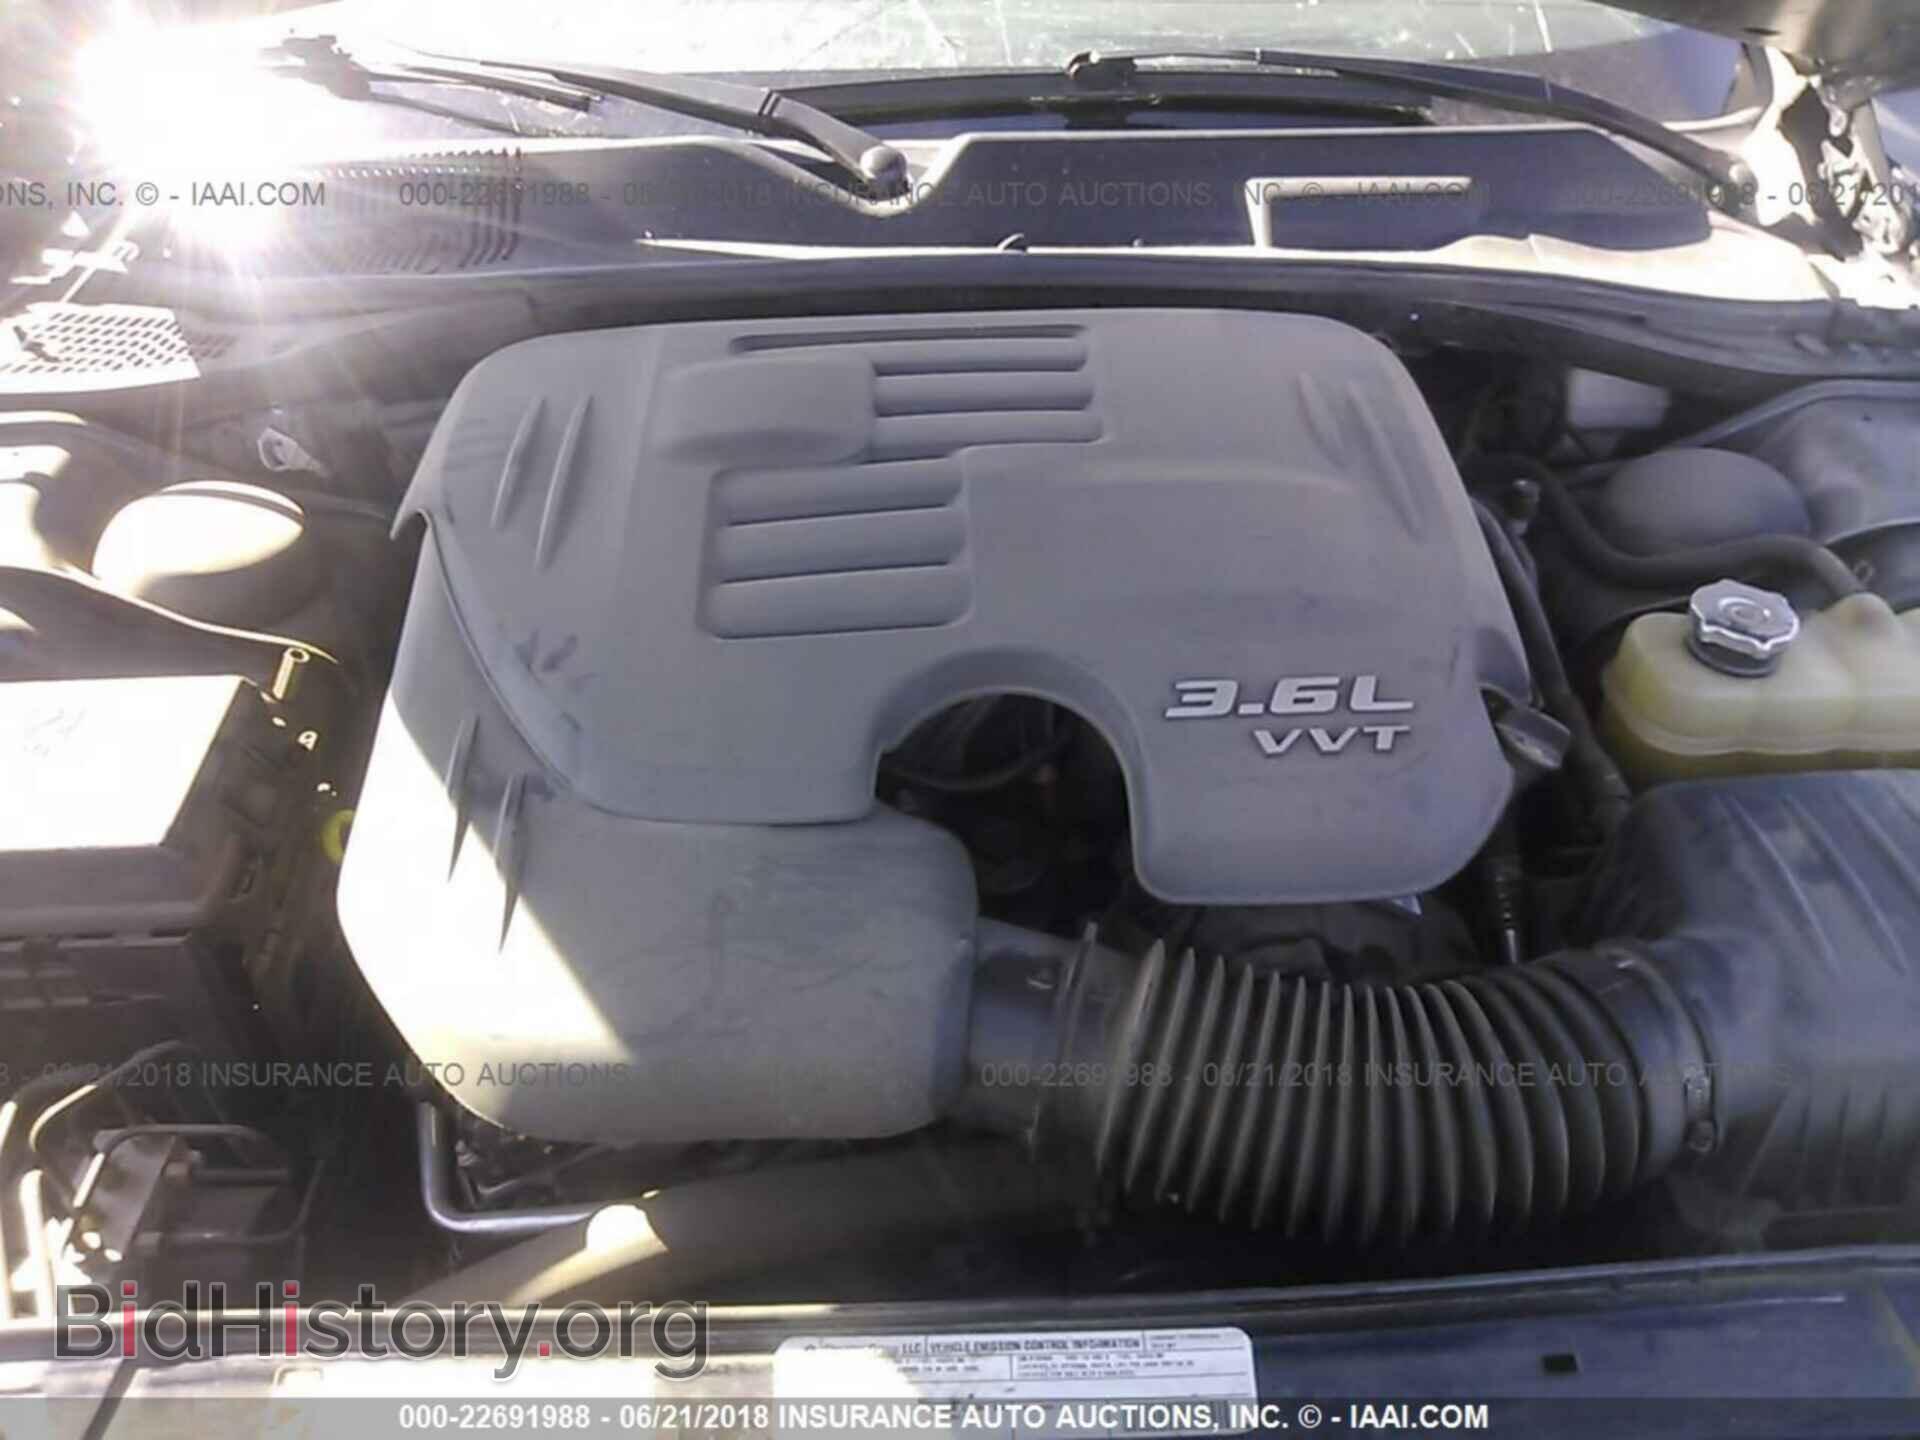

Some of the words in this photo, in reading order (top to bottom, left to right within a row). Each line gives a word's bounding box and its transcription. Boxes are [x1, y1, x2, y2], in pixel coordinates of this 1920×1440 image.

[1165, 675, 1414, 718] 3.6L
[1253, 725, 1411, 754] VVT
[1024, 1339, 1068, 1351] CONTROL
[1072, 1338, 1140, 1350] INFORMATION
